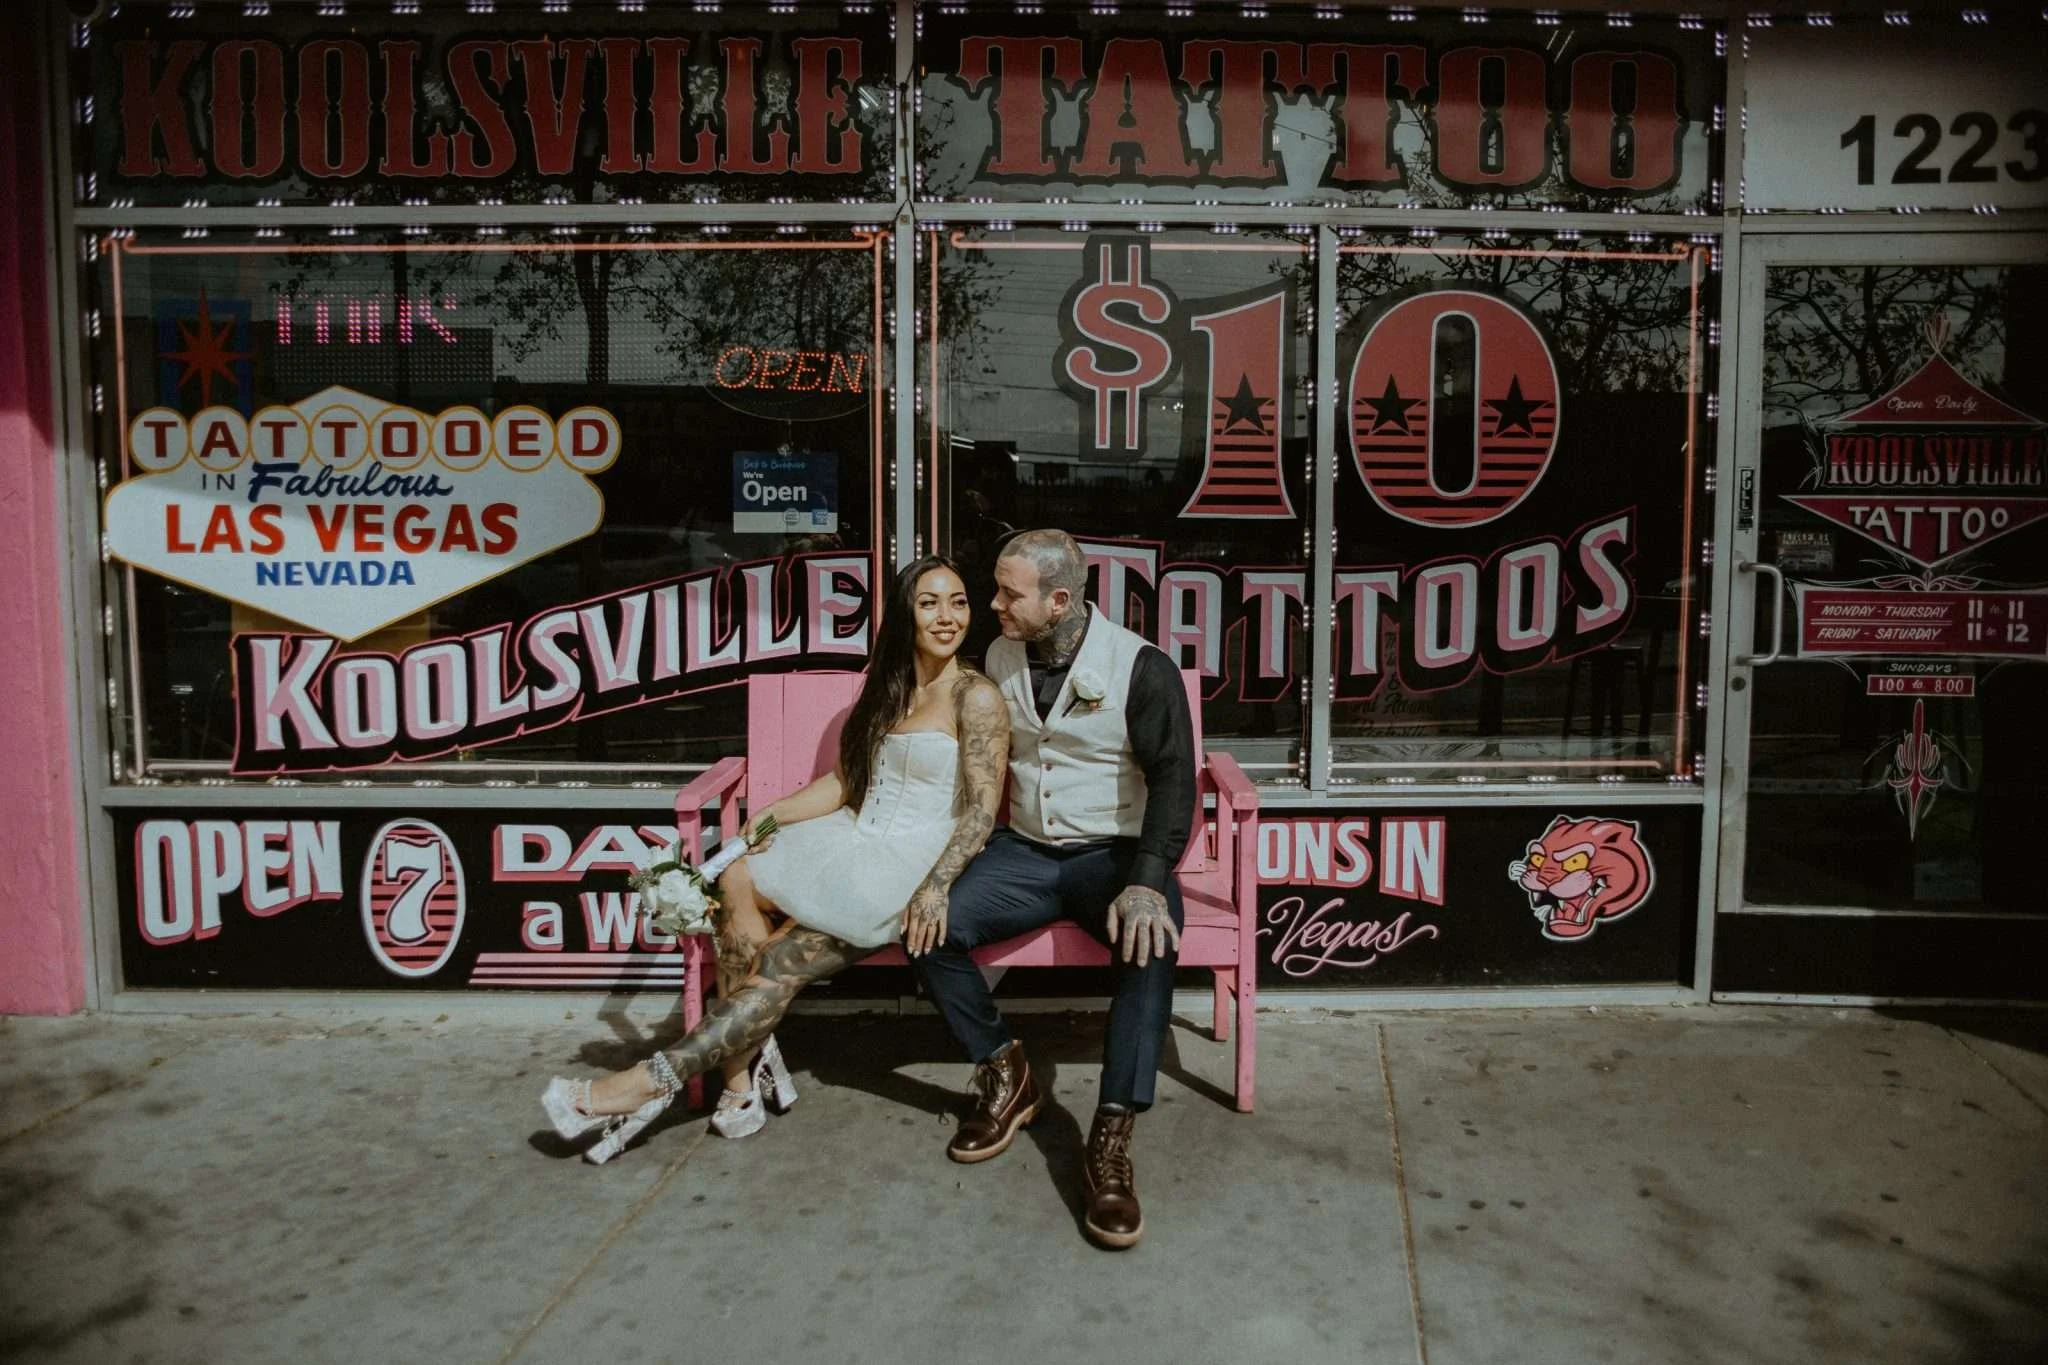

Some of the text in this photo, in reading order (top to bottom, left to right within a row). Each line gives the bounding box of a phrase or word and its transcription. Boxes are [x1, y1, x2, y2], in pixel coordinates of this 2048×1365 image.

[114, 36, 864, 178] KOOLSVILLE
[959, 35, 1680, 188] TATTOO
[1840, 107, 2048, 186] 1223
[714, 346, 869, 393] OPEN
[1065, 243, 1562, 529] $10
[1887, 395, 1924, 413] Open
[143, 418, 610, 459] TATTOOED
[1827, 434, 2042, 486] KOOLSVILLE
[201, 460, 454, 503] IN Fabulous
[742, 480, 808, 507] Open
[1740, 470, 1752, 510] PULL
[166, 502, 519, 556] LAS VEGAS
[1847, 505, 2009, 555] TATTOO
[255, 560, 416, 587] NEVADA
[252, 514, 1630, 752] KOOLSVILLE TATTOOS
[1817, 627, 1860, 640] FRIDAY
[1874, 627, 1942, 640] SATURDAY
[2006, 623, 2030, 643] 12
[1821, 604, 1876, 617] MONDAY
[1884, 605, 1949, 618] THURSDAY
[1889, 663, 1953, 674] SUNDAYS
[135, 819, 342, 946] OPEN
[381, 835, 443, 945] 7
[1379, 815, 1447, 906] IN
[521, 900, 565, 952] a
[1257, 895, 1438, 977] Vegas
